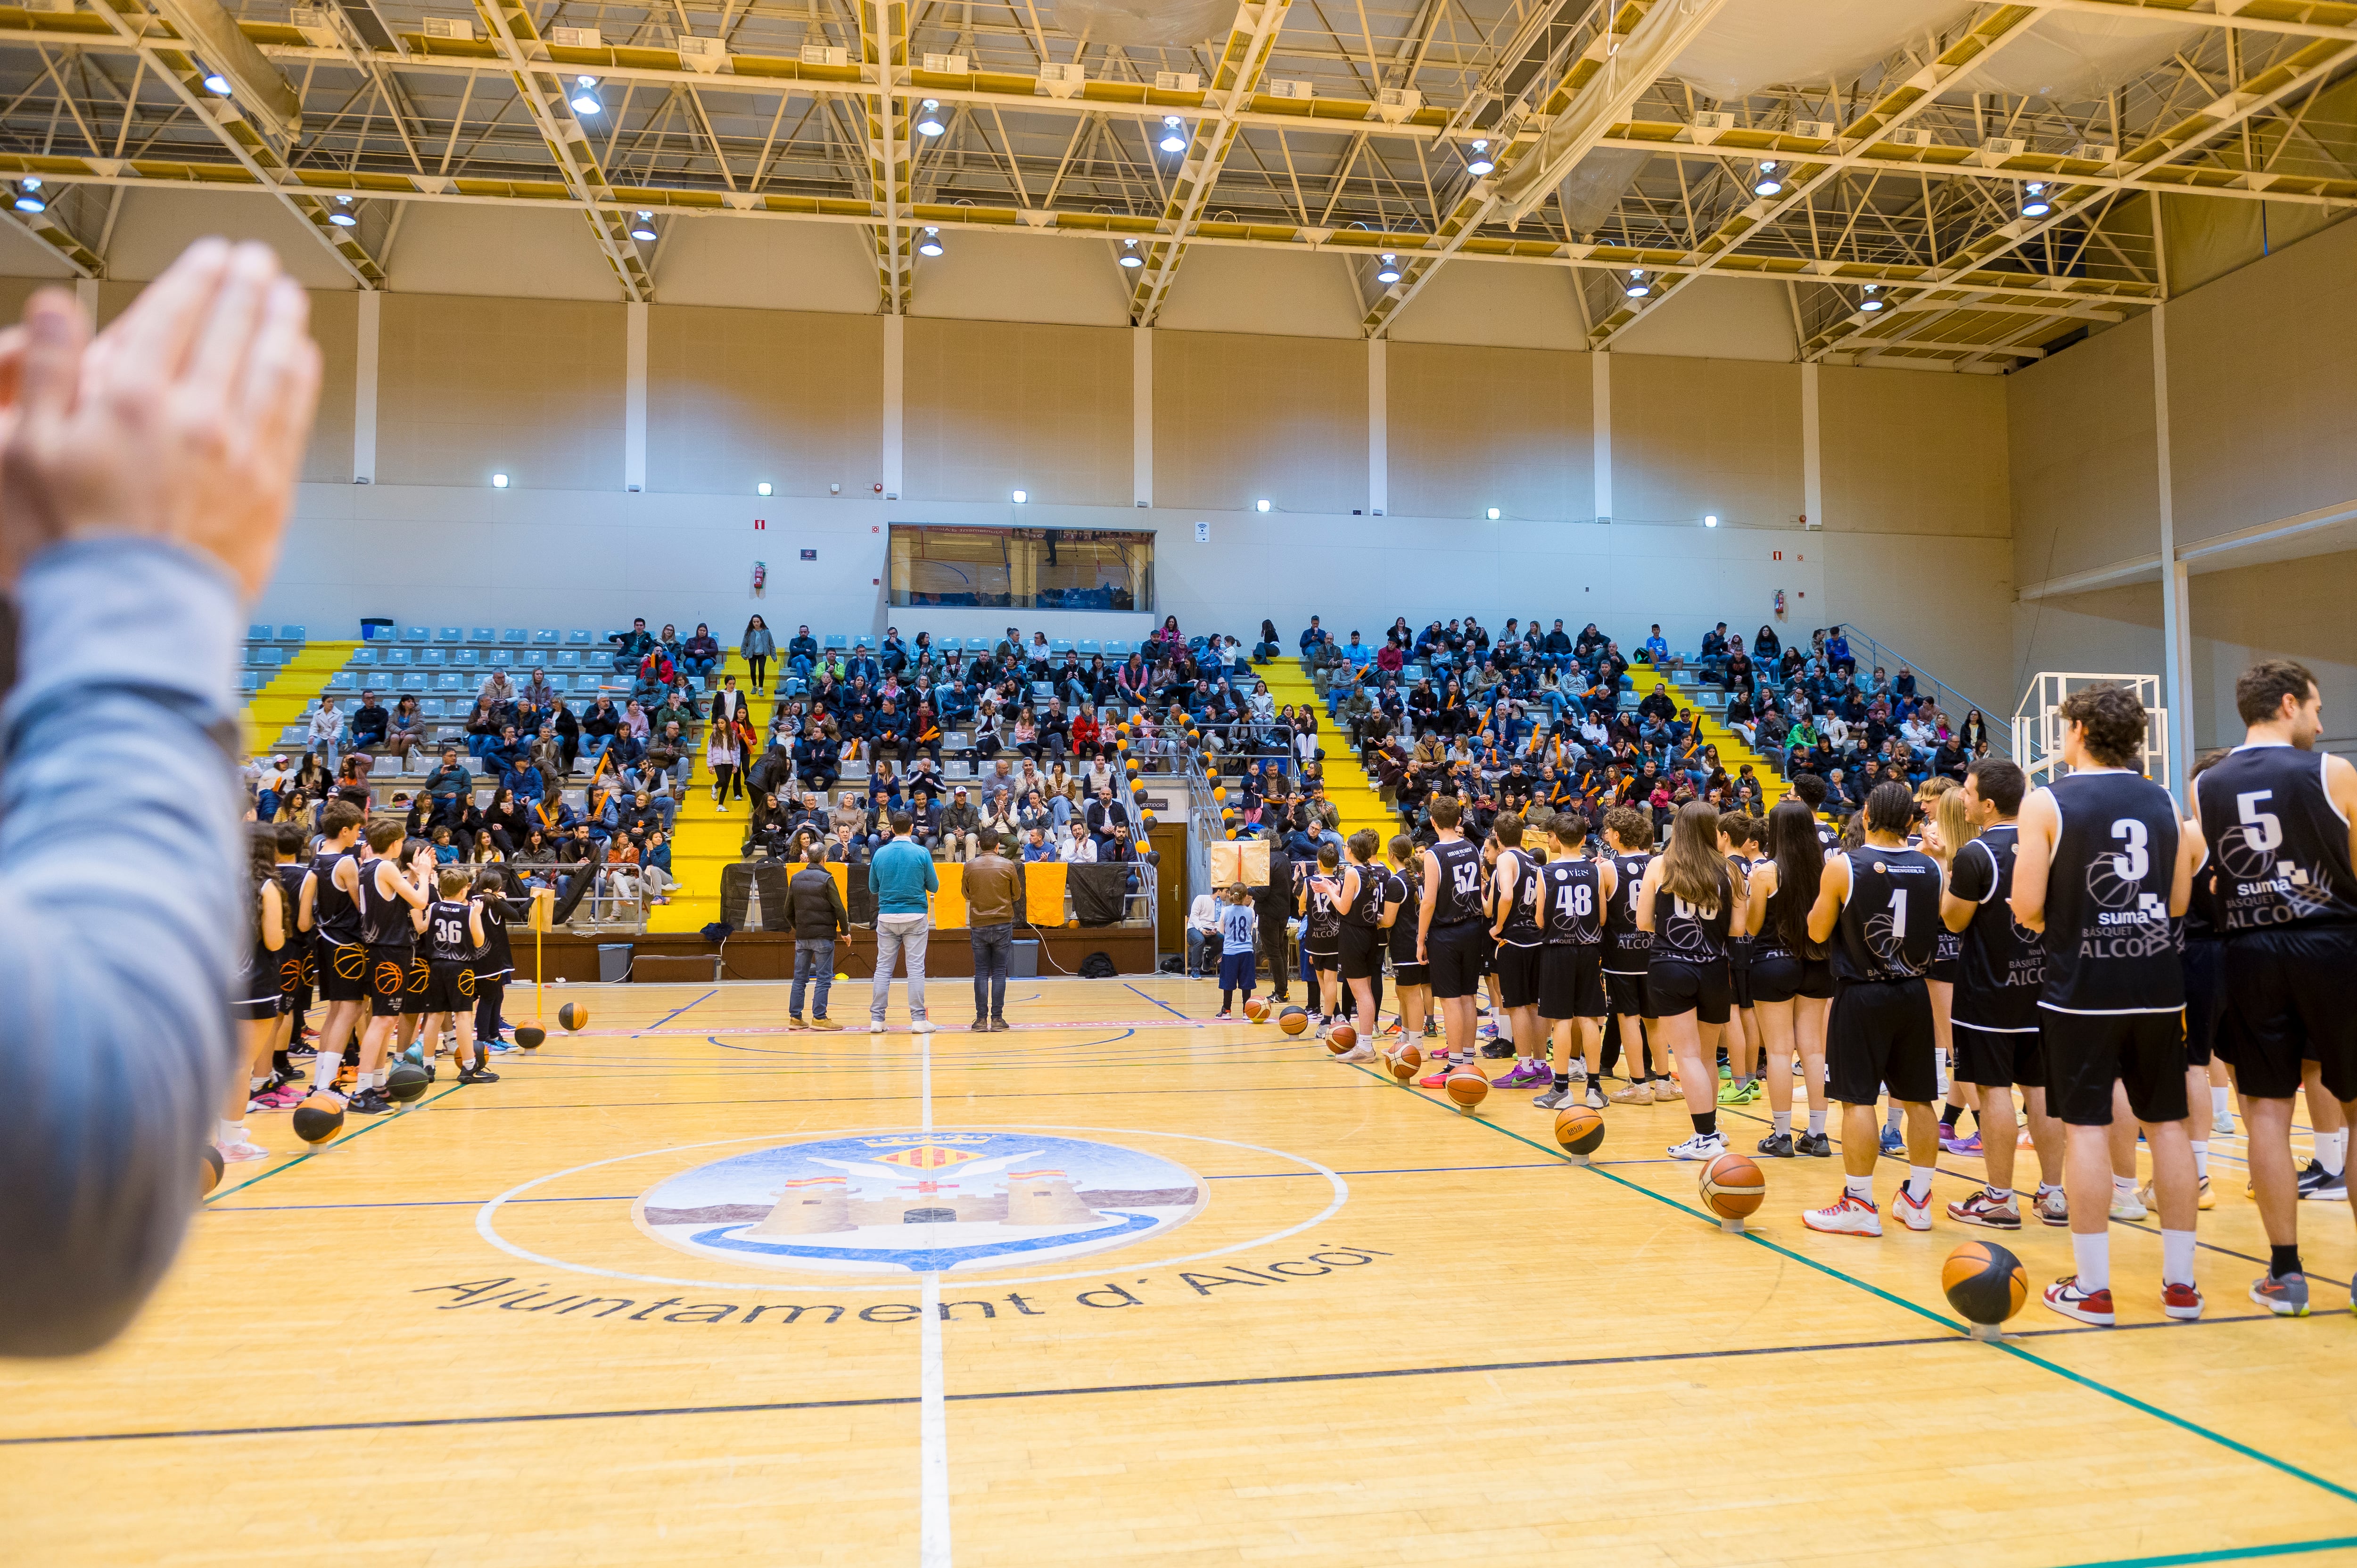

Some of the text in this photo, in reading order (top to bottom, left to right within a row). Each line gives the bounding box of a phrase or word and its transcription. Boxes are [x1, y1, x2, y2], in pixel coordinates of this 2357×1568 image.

[699, 701, 709, 712] G
[690, 727, 701, 739] F
[2237, 789, 2283, 851] 5
[2110, 818, 2149, 880] 3
[1452, 862, 1480, 895] 52
[1569, 869, 1589, 877] vias
[2237, 878, 2291, 896] suma
[1313, 892, 1331, 913] 12
[1556, 884, 1592, 917] 48
[1887, 888, 1907, 938] 1
[2098, 911, 2150, 925] suma
[435, 918, 462, 944] 36
[1229, 915, 1247, 943] 18
[2081, 927, 2134, 937] BÀSQUET
[2009, 957, 2042, 969] BÀSQUET
[413, 1277, 1045, 1324] Ajuntament
